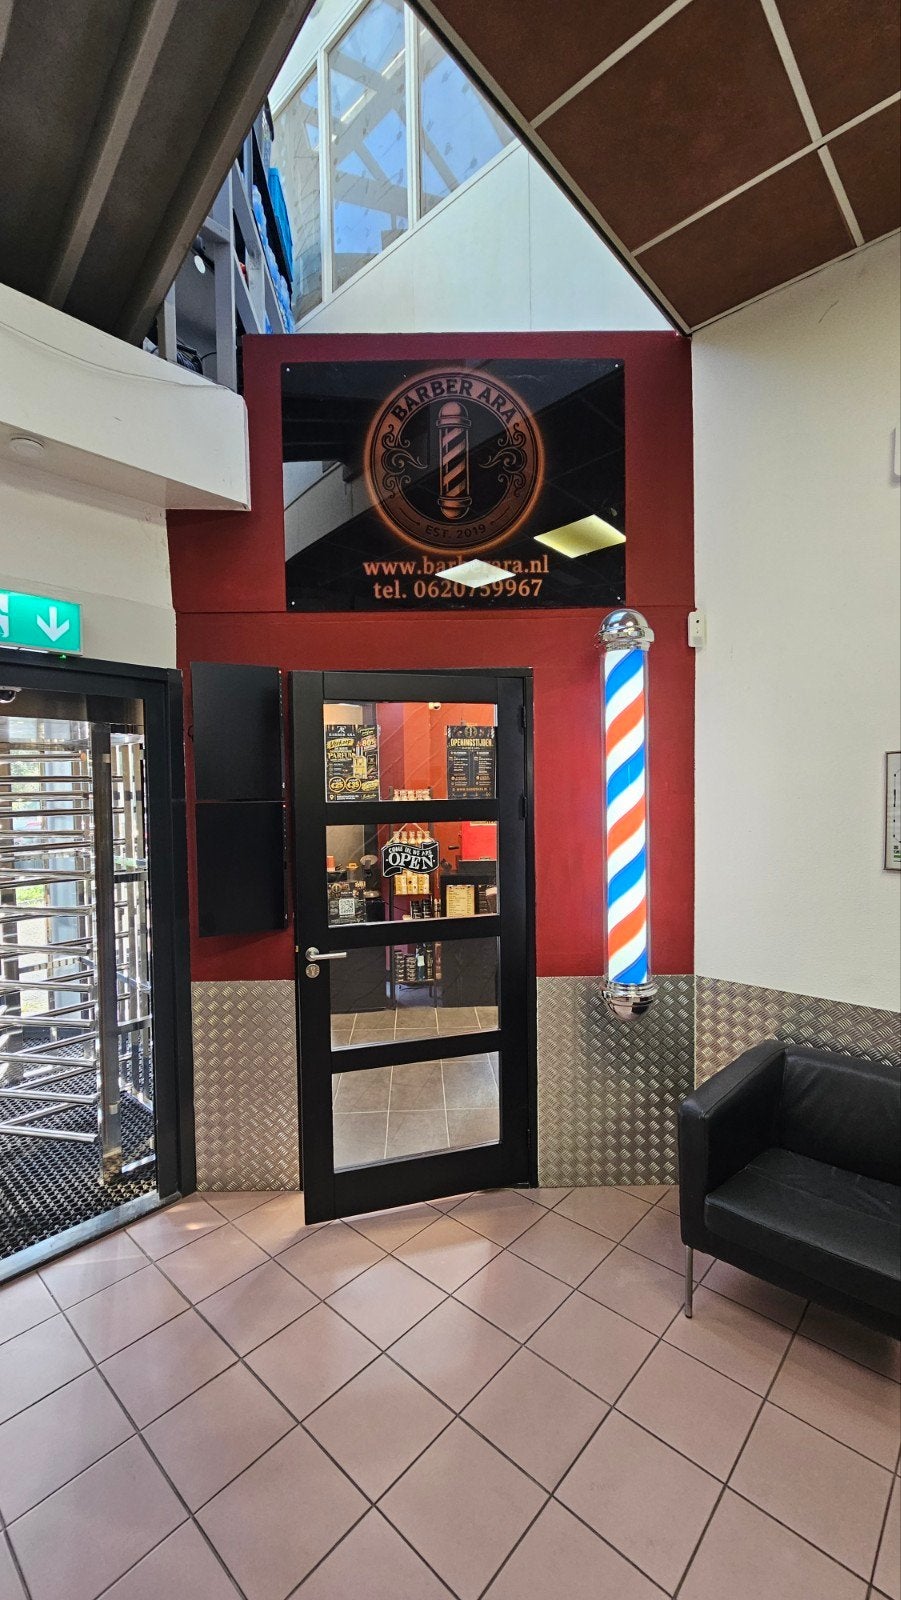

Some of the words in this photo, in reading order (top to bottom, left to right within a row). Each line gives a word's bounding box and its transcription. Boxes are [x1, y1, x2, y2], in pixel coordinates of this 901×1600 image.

[391, 378, 473, 420] BARBER
[477, 386, 517, 424] ARA
[425, 524, 452, 539] EST.
[456, 524, 487, 539] 2019
[363, 554, 550, 575] www.barra.nl
[373, 580, 407, 599] tel.
[450, 738, 492, 747] OPENINGSTIJDEN
[388, 846, 403, 854] COME
[388, 852, 434, 870] OPEN
